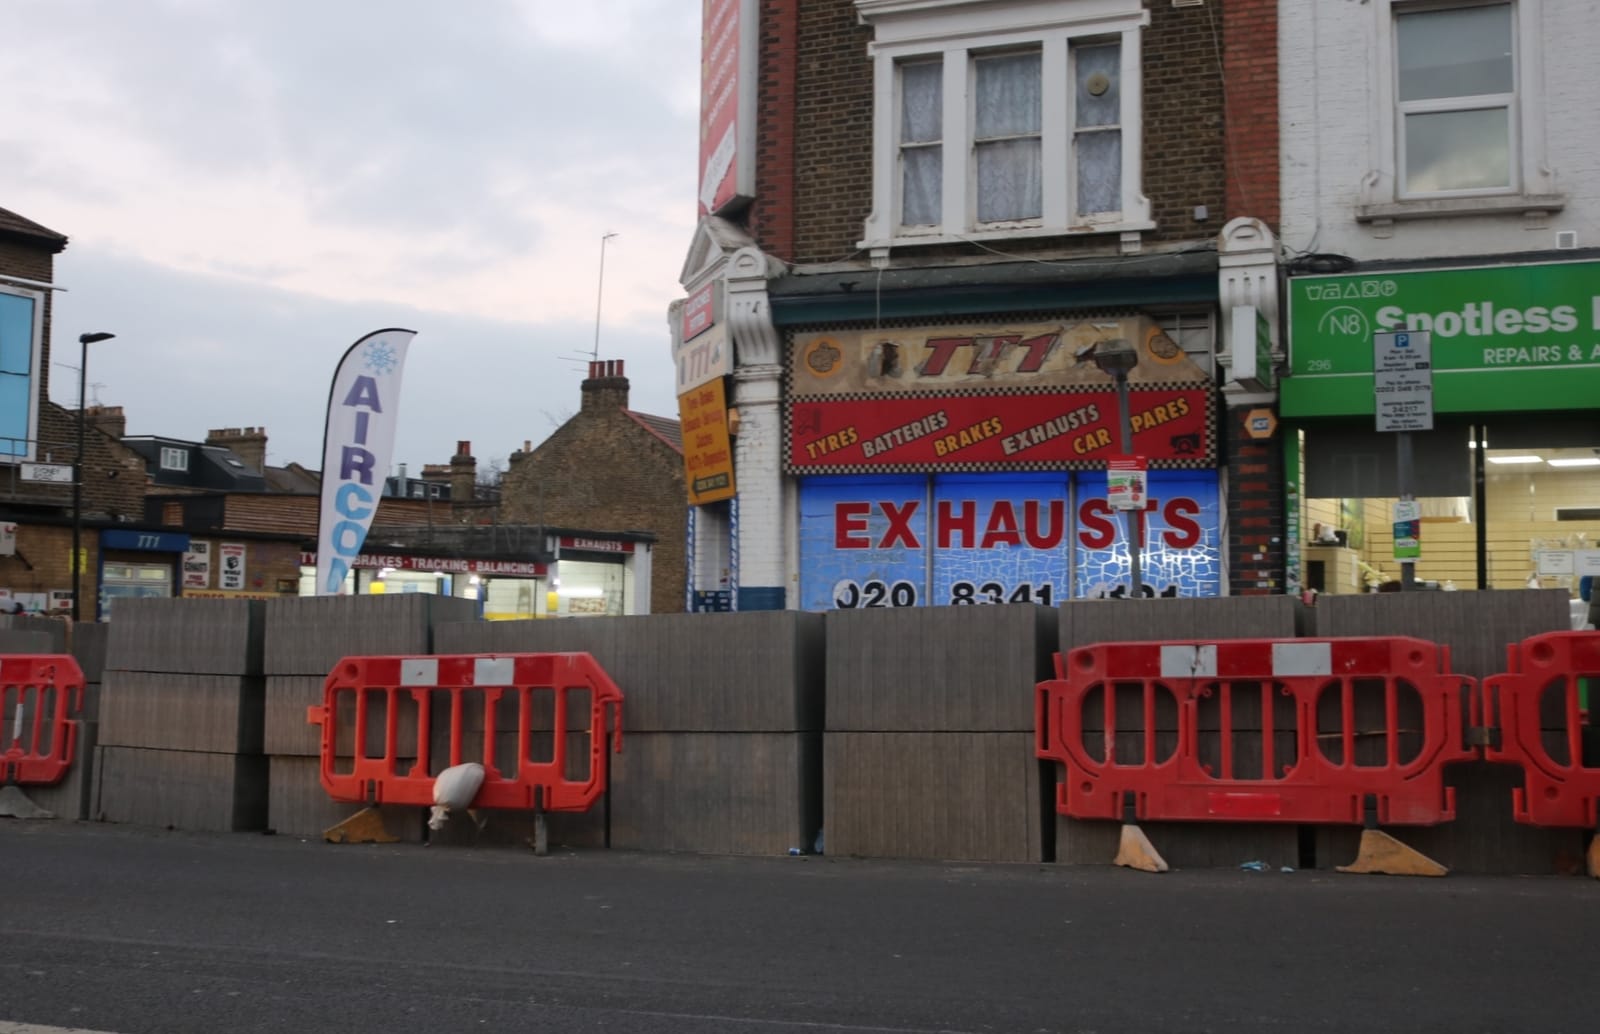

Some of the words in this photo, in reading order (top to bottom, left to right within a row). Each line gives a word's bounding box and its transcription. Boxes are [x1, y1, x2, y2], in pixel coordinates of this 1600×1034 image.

[1330, 314, 1361, 336] N8
[1307, 360, 1331, 371] 296
[1483, 345, 1562, 364] REPAIRS
[1568, 344, 1583, 361] &
[861, 410, 949, 459] BATTERIES
[933, 416, 1004, 458] BRAKES
[1002, 404, 1101, 456] EXHAUSTS
[1072, 428, 1113, 455] CAR
[1129, 397, 1191, 434] PARES
[805, 426, 859, 460] TYRES
[573, 538, 623, 551] EXHAUSTS
[353, 554, 404, 568] BRAKES
[410, 558, 469, 572] TRACKING
[476, 560, 535, 574] BALANCING
